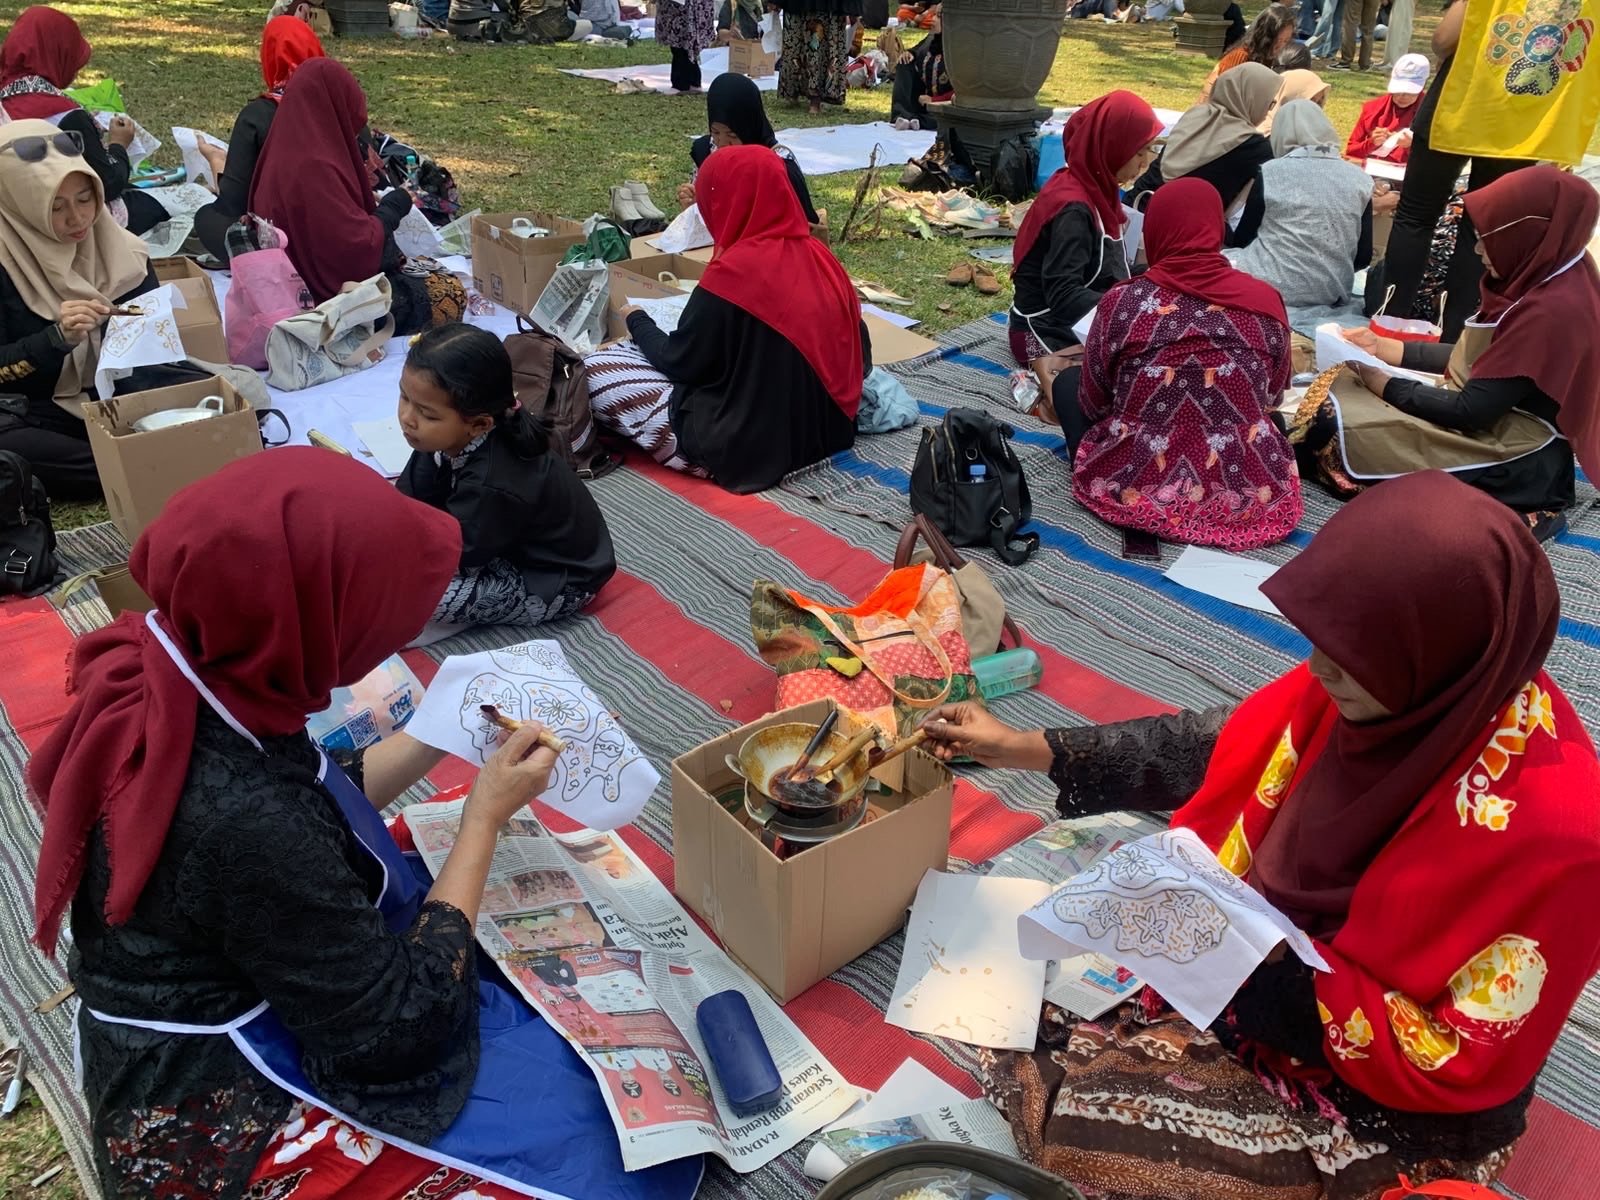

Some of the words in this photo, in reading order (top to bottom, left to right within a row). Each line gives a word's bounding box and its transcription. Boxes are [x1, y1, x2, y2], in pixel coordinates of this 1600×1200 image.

[654, 925, 689, 941] Ajak
[789, 1063, 823, 1088] Kades
[790, 1073, 834, 1106] Setoran
[769, 1104, 794, 1122] PBB
[939, 1106, 954, 1120] Ke
[629, 1135, 636, 1143] 3
[739, 1130, 780, 1157] RADAR
